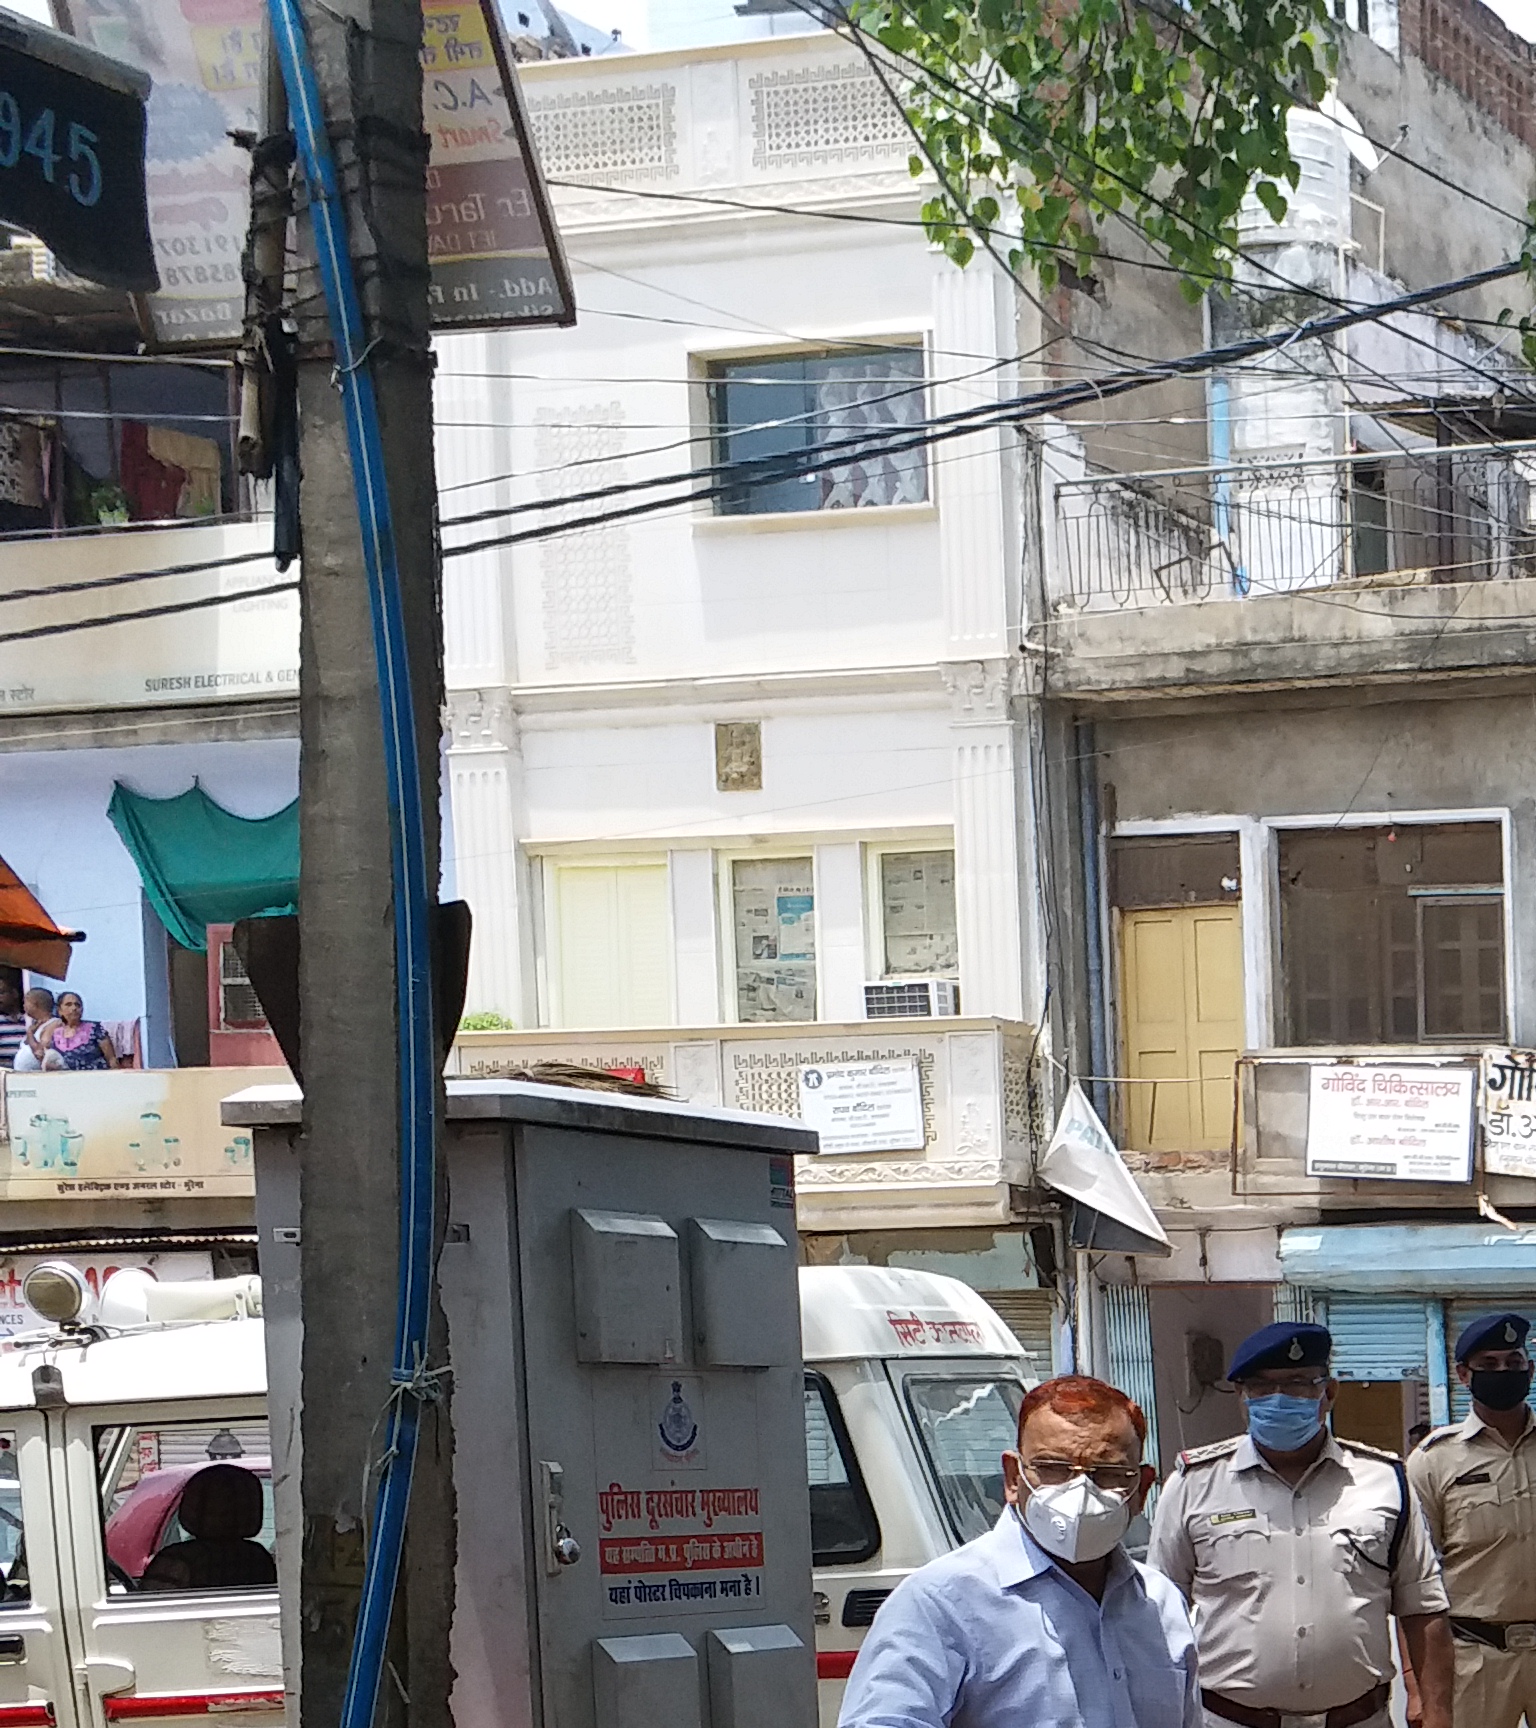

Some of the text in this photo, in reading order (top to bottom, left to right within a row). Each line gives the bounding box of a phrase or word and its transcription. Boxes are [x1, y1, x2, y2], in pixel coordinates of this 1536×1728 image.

[145, 669, 301, 693] SURESH ELECTRICAL & GEN
[1321, 1072, 1461, 1097] गोविंद चिकित्सालय
[0, 1314, 24, 1327] NCES
[599, 1479, 760, 1532] पुलिस दूरसंचार मुख्यालय
[608, 1580, 631, 1605] यहां
[634, 1579, 667, 1602] पोस्टर
[669, 1578, 717, 1602] चिपकाना
[719, 1579, 742, 1598] मना
